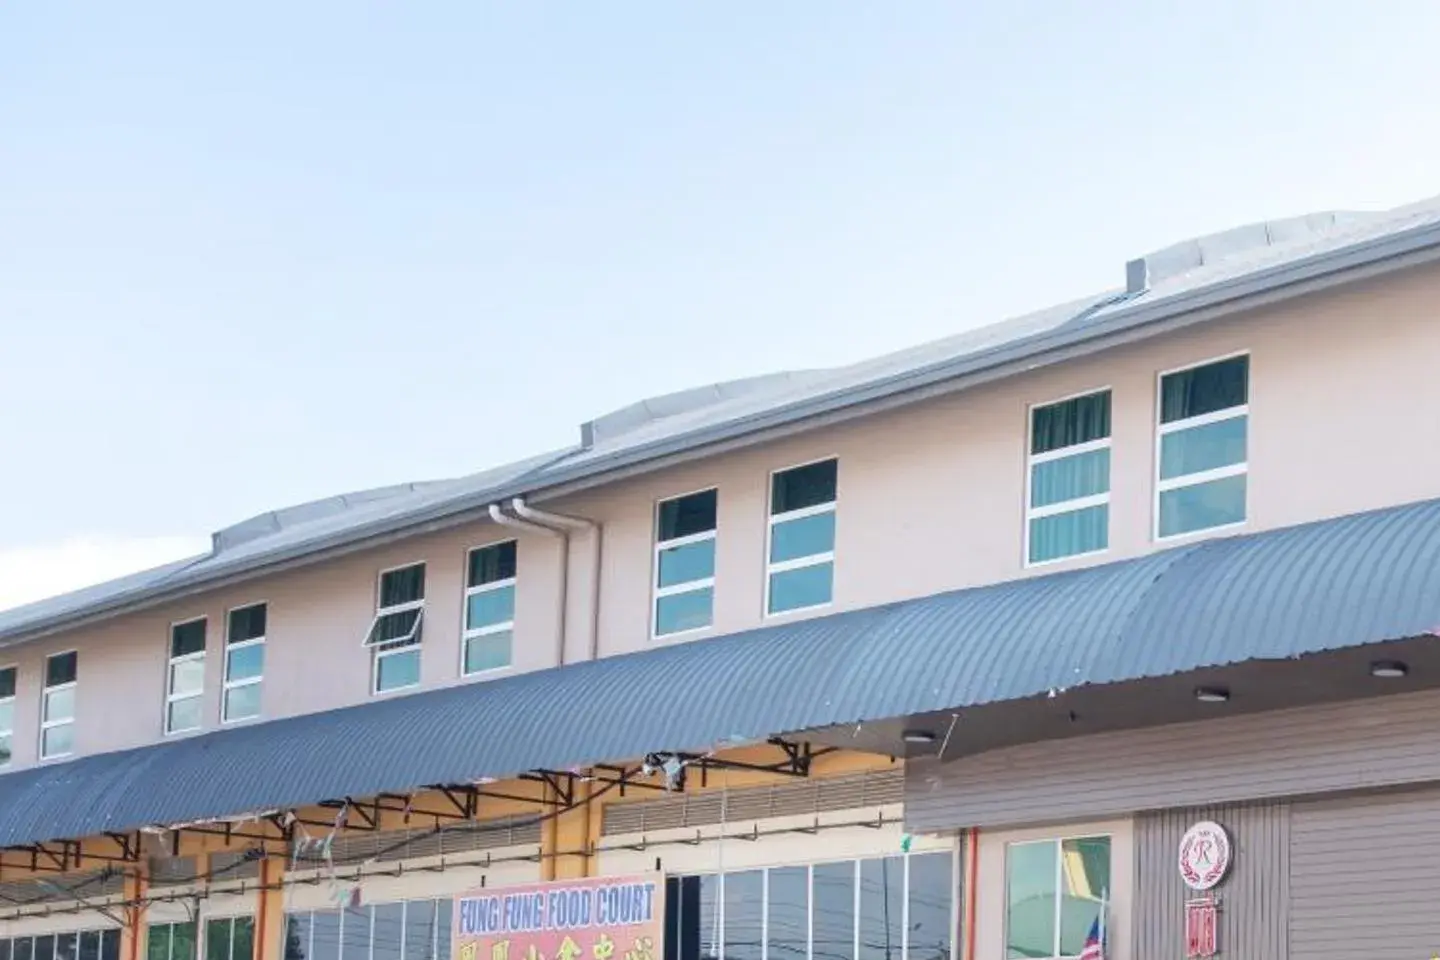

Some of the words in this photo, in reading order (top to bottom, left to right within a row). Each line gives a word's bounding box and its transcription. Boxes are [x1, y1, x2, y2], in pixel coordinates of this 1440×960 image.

[459, 896, 499, 935] FUNG
[502, 892, 545, 932] FUNG
[547, 888, 592, 928] FOOD
[596, 882, 656, 925] COURT
